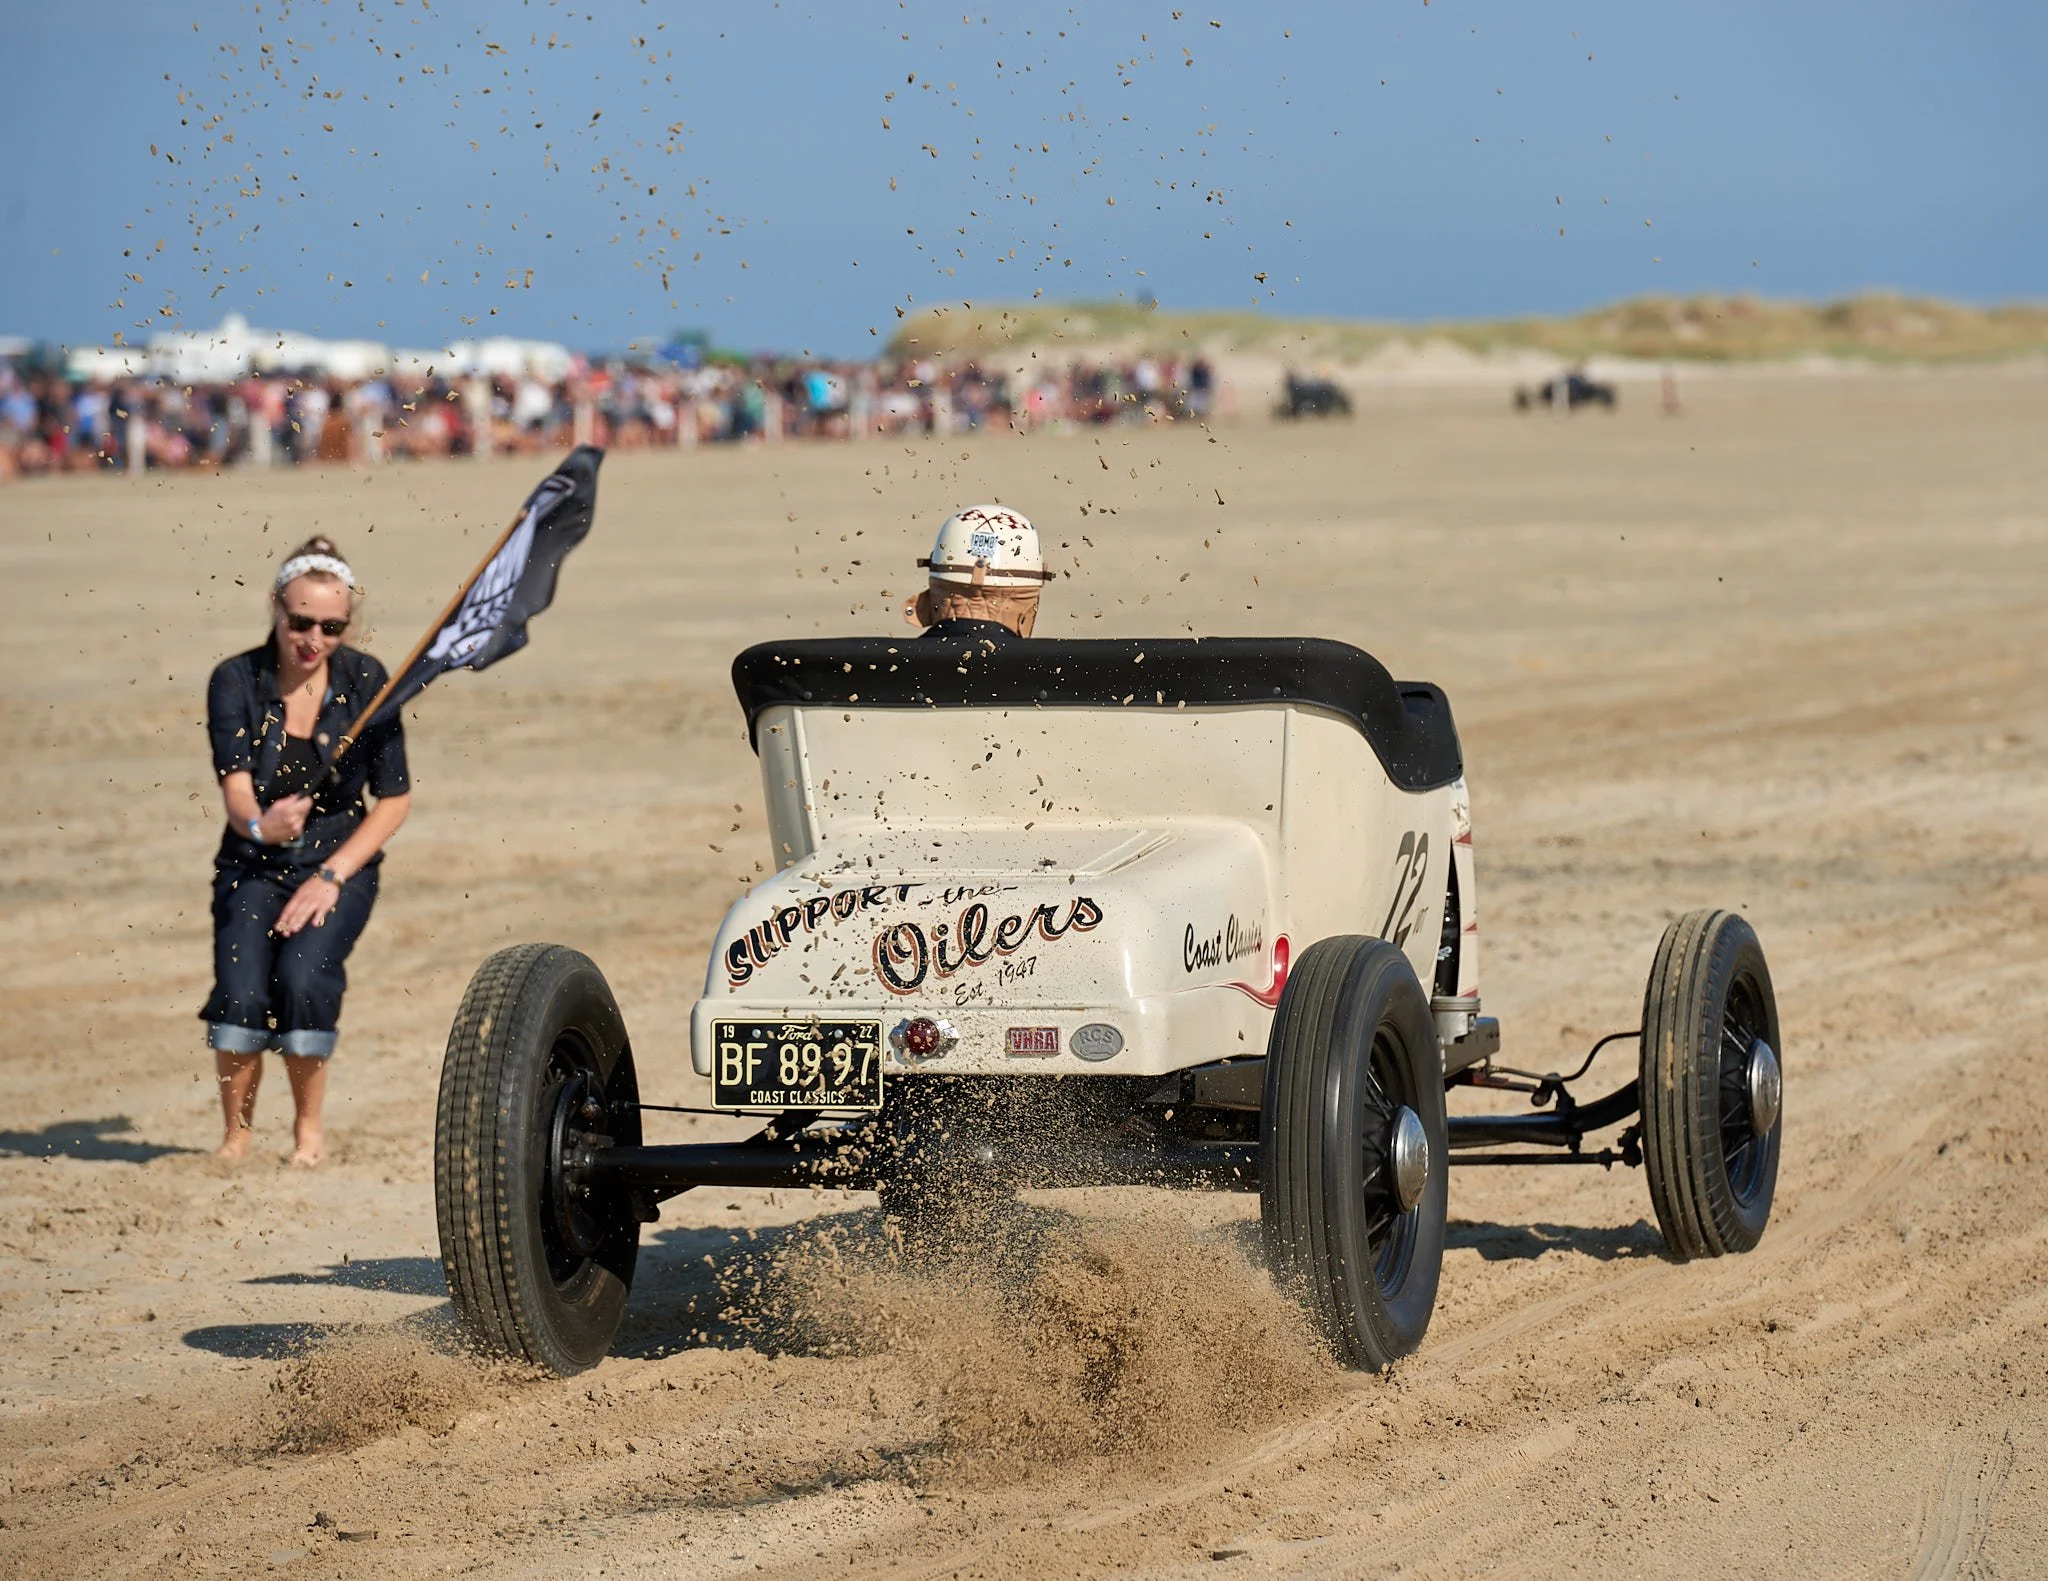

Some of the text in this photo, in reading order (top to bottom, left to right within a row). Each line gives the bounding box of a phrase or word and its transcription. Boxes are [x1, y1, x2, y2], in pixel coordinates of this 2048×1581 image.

[724, 882, 926, 986] SUPPORT
[872, 896, 1103, 996] Oilers
[1184, 922, 1222, 973] Coast
[996, 956, 1037, 986] 1947
[722, 1025, 735, 1039] 19
[777, 1024, 813, 1041] Ford
[720, 1043, 873, 1087] BF 89 97
[751, 1090, 846, 1104] COAST CLASSICS
